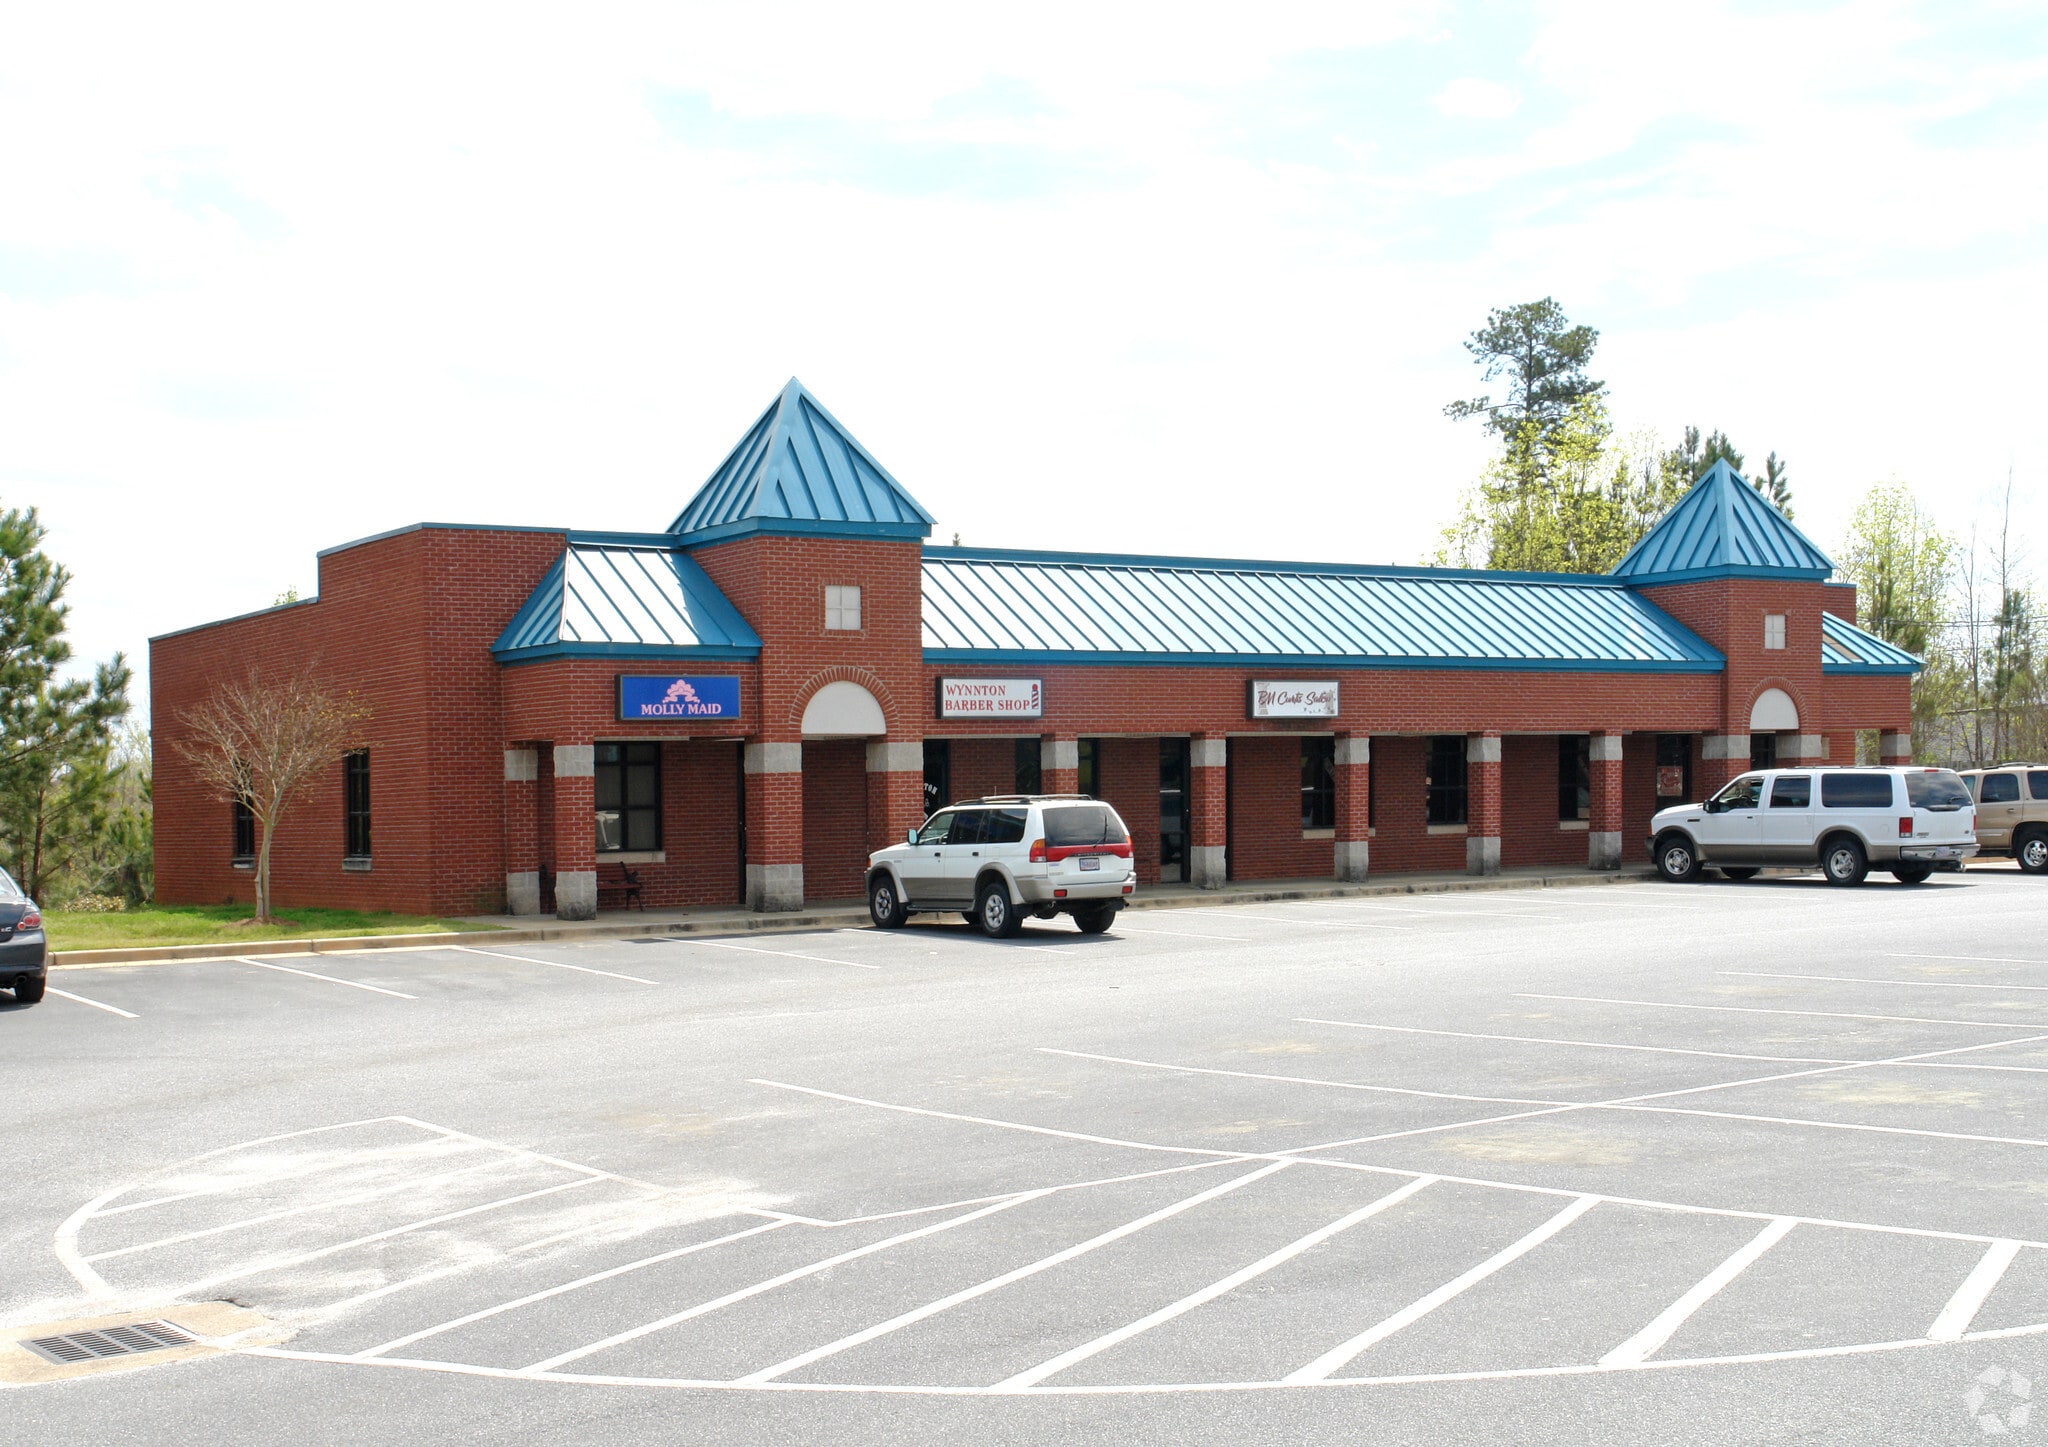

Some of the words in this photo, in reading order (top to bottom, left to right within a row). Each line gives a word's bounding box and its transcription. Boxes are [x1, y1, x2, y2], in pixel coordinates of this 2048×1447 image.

[946, 684, 1006, 696] WYNNTON
[1304, 691, 1332, 706] Salon
[641, 703, 685, 715] MOLLY
[687, 703, 722, 715] MAID
[945, 699, 994, 711] BARBER
[998, 699, 1030, 711] SHOP
